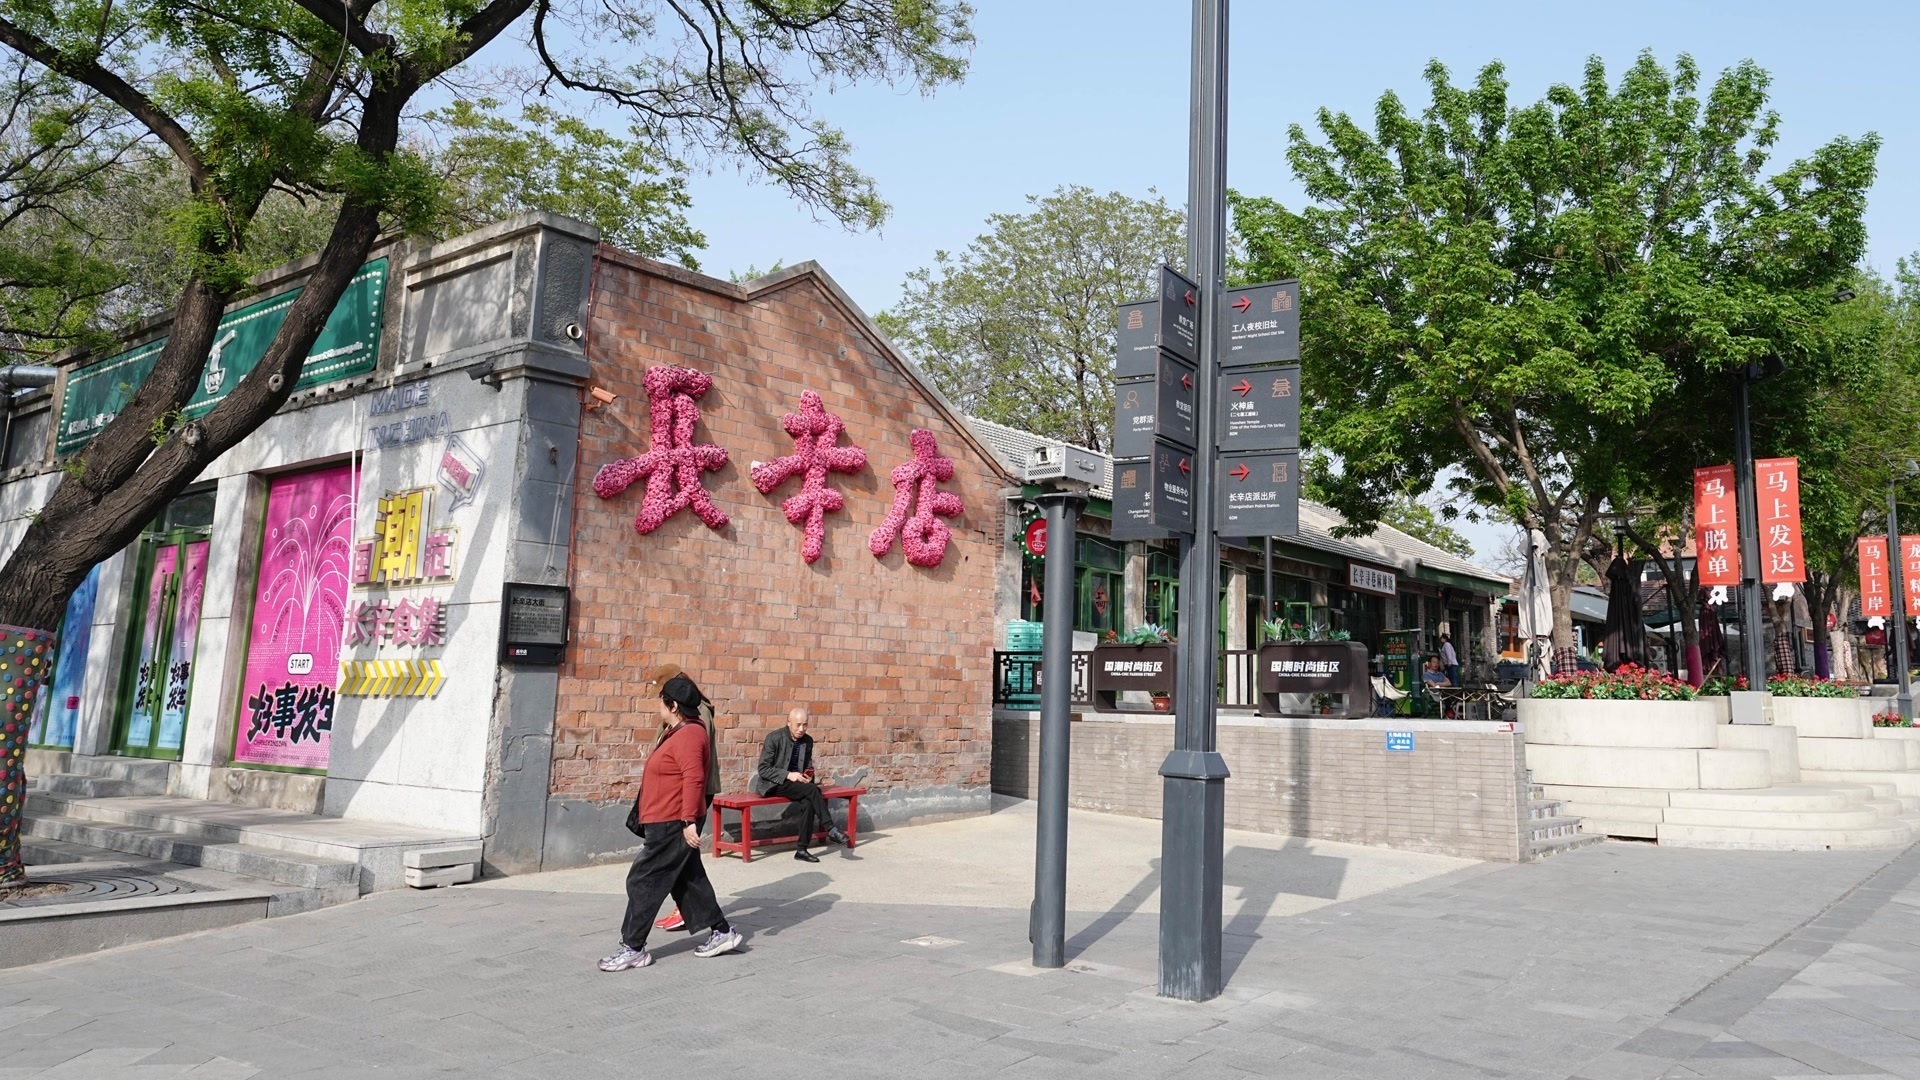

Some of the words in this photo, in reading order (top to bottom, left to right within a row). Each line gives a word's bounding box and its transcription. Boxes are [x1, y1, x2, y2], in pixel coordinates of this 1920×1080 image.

[1231, 320, 1278, 333] 工人夜校旧址
[369, 379, 431, 417] MADE
[1230, 401, 1255, 411] 火神庙
[1228, 491, 1277, 502] 长辛店派出所
[1702, 477, 1730, 578] 马上脱单
[1765, 470, 1795, 575] 马上发达
[1865, 545, 1883, 612] 马上上岸
[512, 596, 546, 607] 长辛店大街
[345, 597, 446, 649] 长辛食集
[290, 658, 311, 669] START
[1104, 661, 1164, 673] 国潮时尚街区
[1270, 660, 1340, 673] 国潮时尚街区
